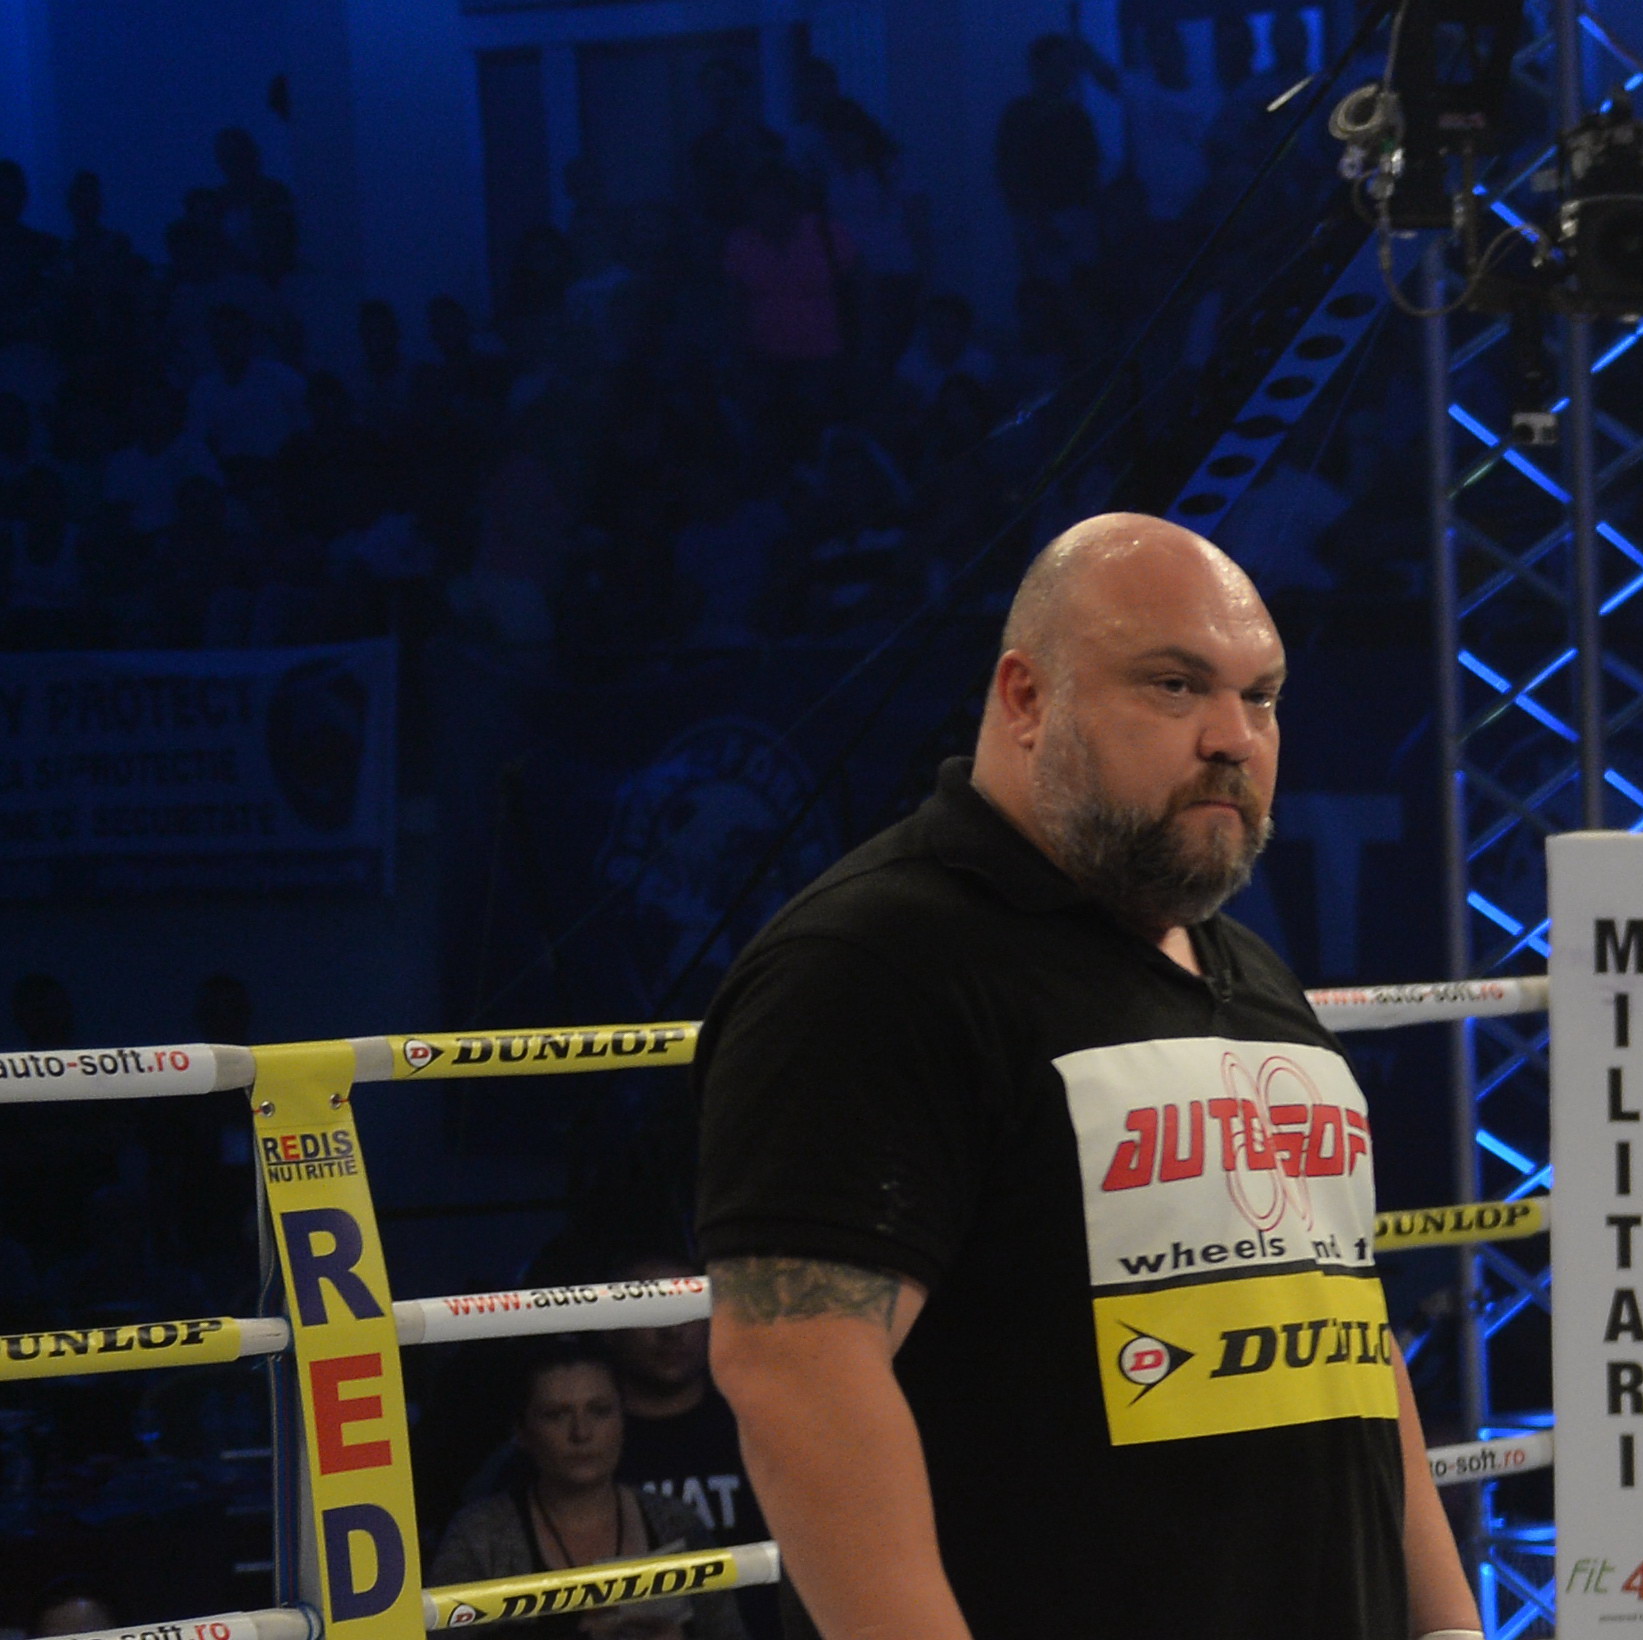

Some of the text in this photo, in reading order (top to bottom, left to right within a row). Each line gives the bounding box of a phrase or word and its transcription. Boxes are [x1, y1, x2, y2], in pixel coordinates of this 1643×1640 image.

[452, 1029, 685, 1065] DUNLOP
[262, 1130, 354, 1163] REDIS
[1101, 1097, 1373, 1193] AUTOSOF
[268, 1159, 358, 1184] NUTRITIE
[1118, 1228, 1287, 1276] wheels
[444, 1277, 705, 1317] www.auto-soft.ro
[6, 1320, 223, 1362] UNLOP
[1209, 1317, 1393, 1380] DUNLO
[500, 1560, 725, 1620] DUNLOP
